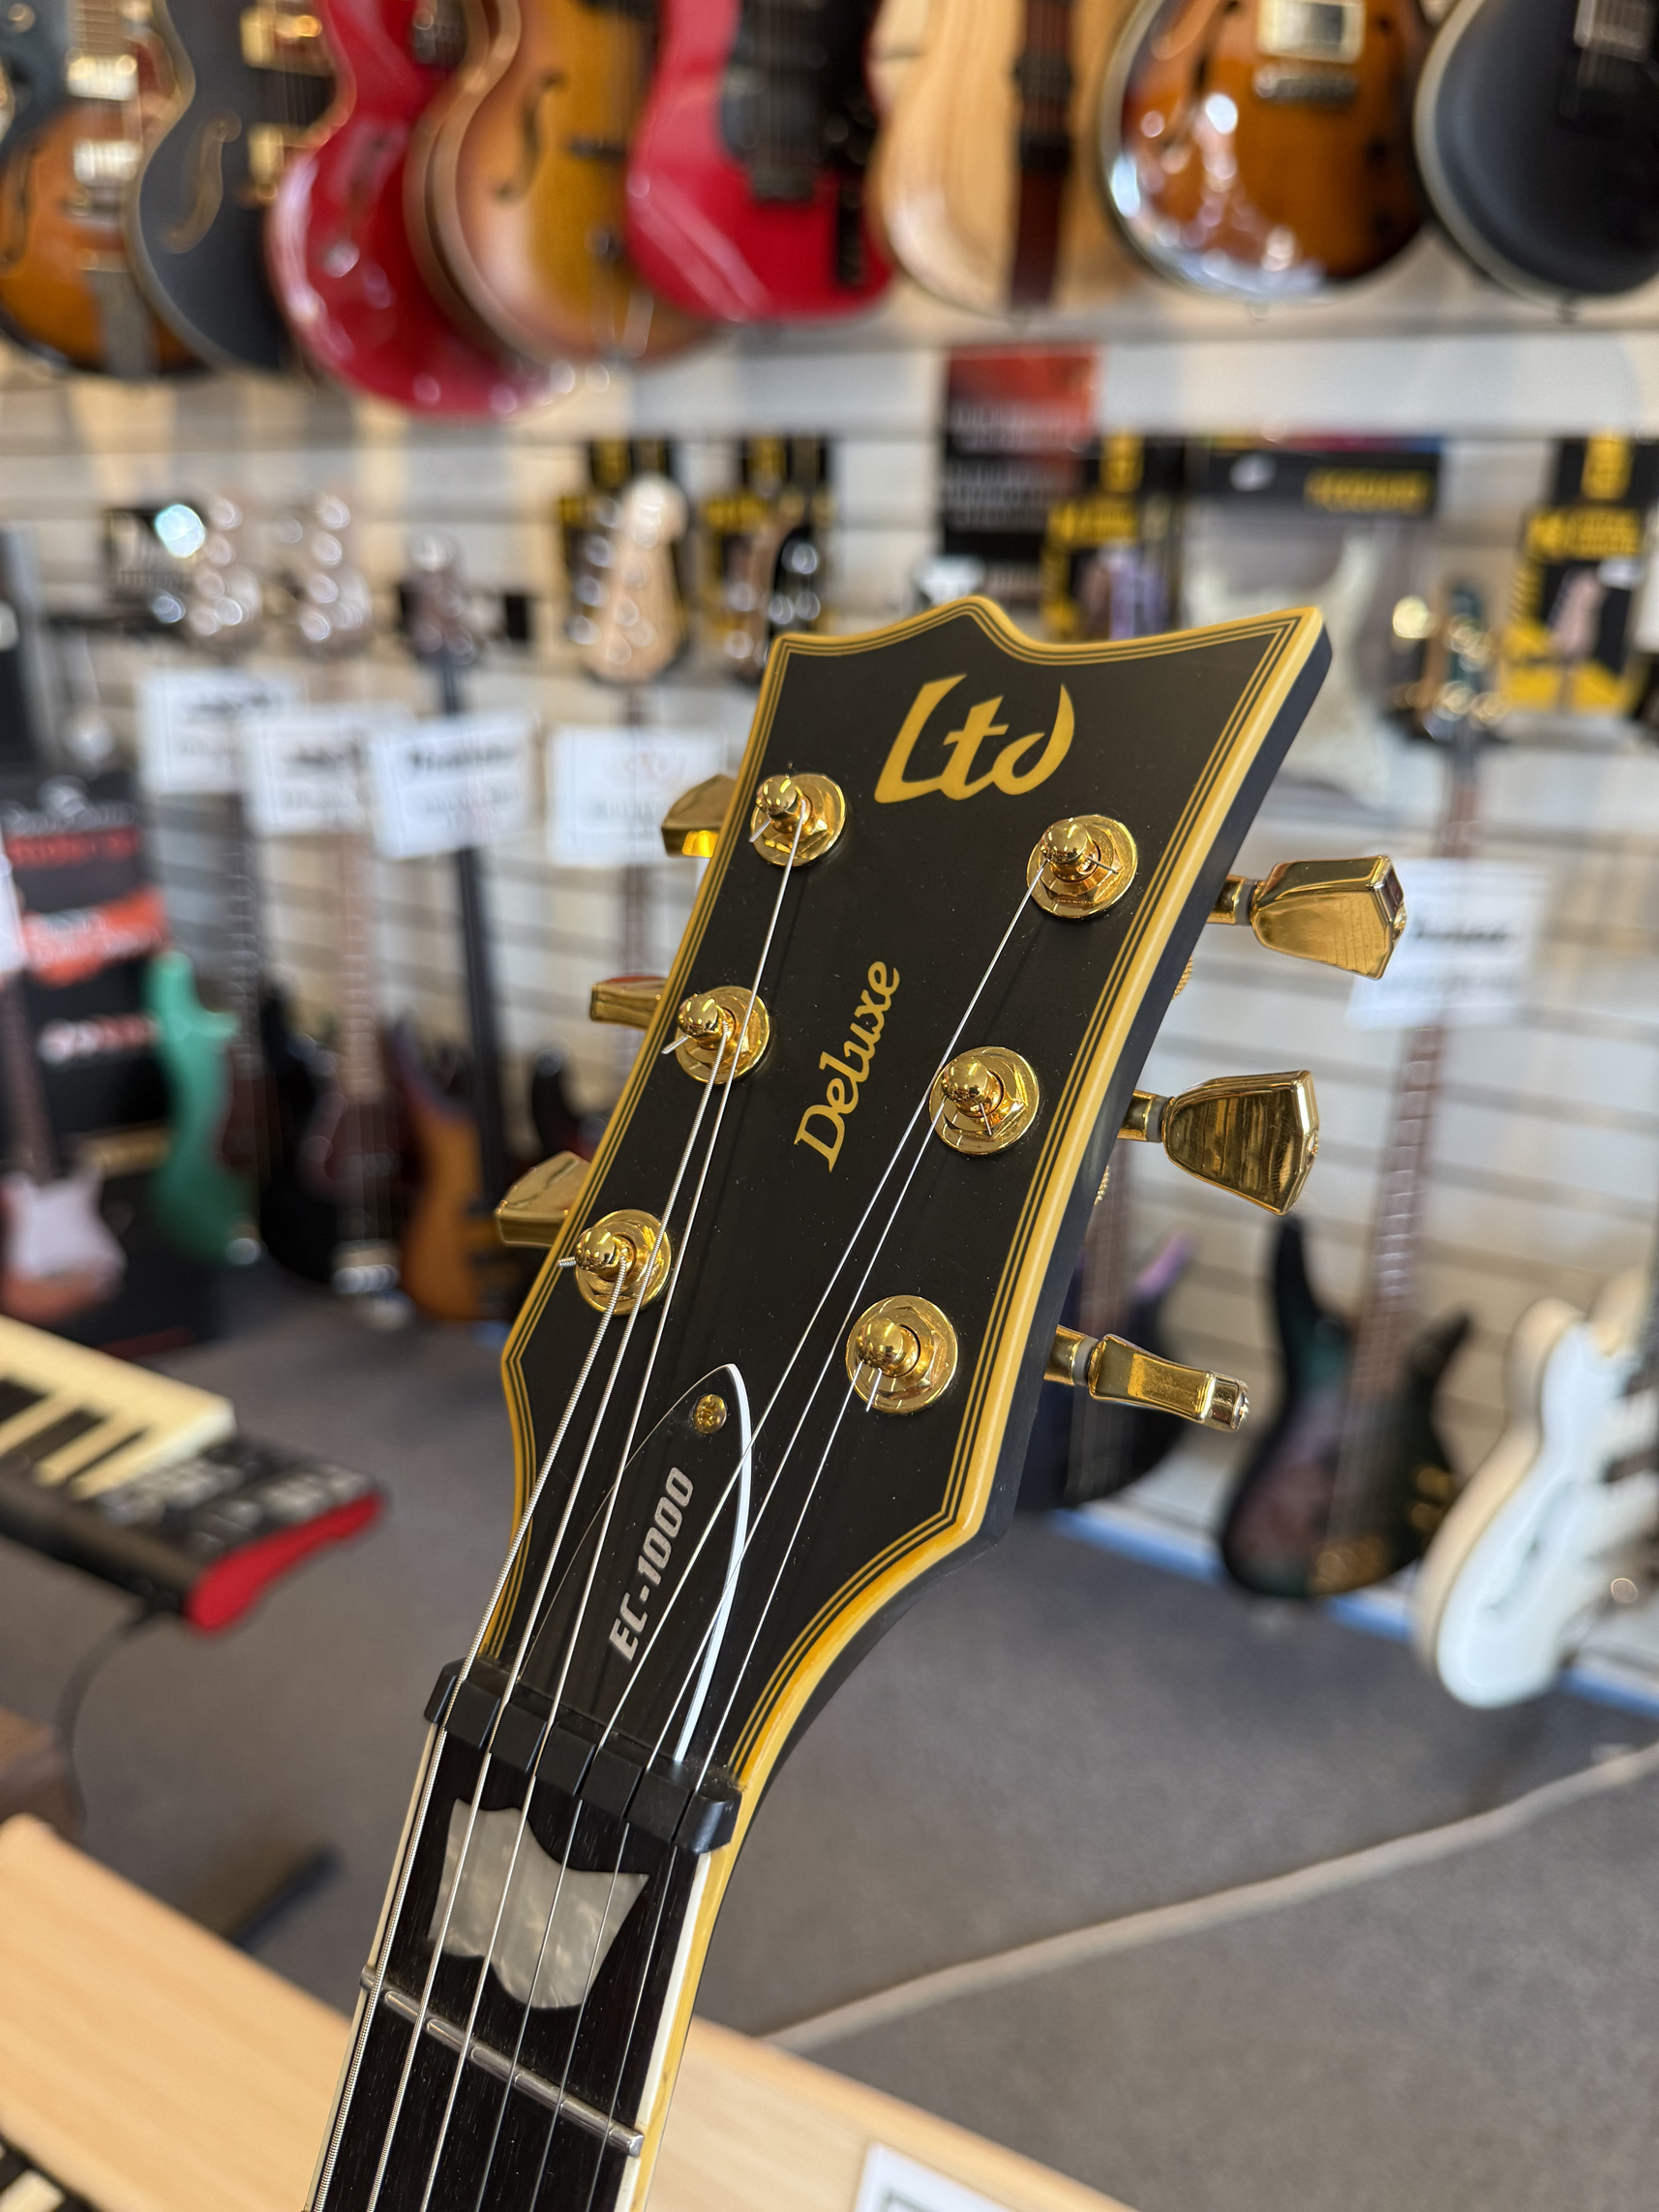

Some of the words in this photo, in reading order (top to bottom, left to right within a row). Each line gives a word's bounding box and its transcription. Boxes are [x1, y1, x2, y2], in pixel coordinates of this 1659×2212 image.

[874, 673, 1074, 803] Ltd
[794, 961, 900, 1172] Deluxe
[609, 1467, 694, 1661] EC-1000
